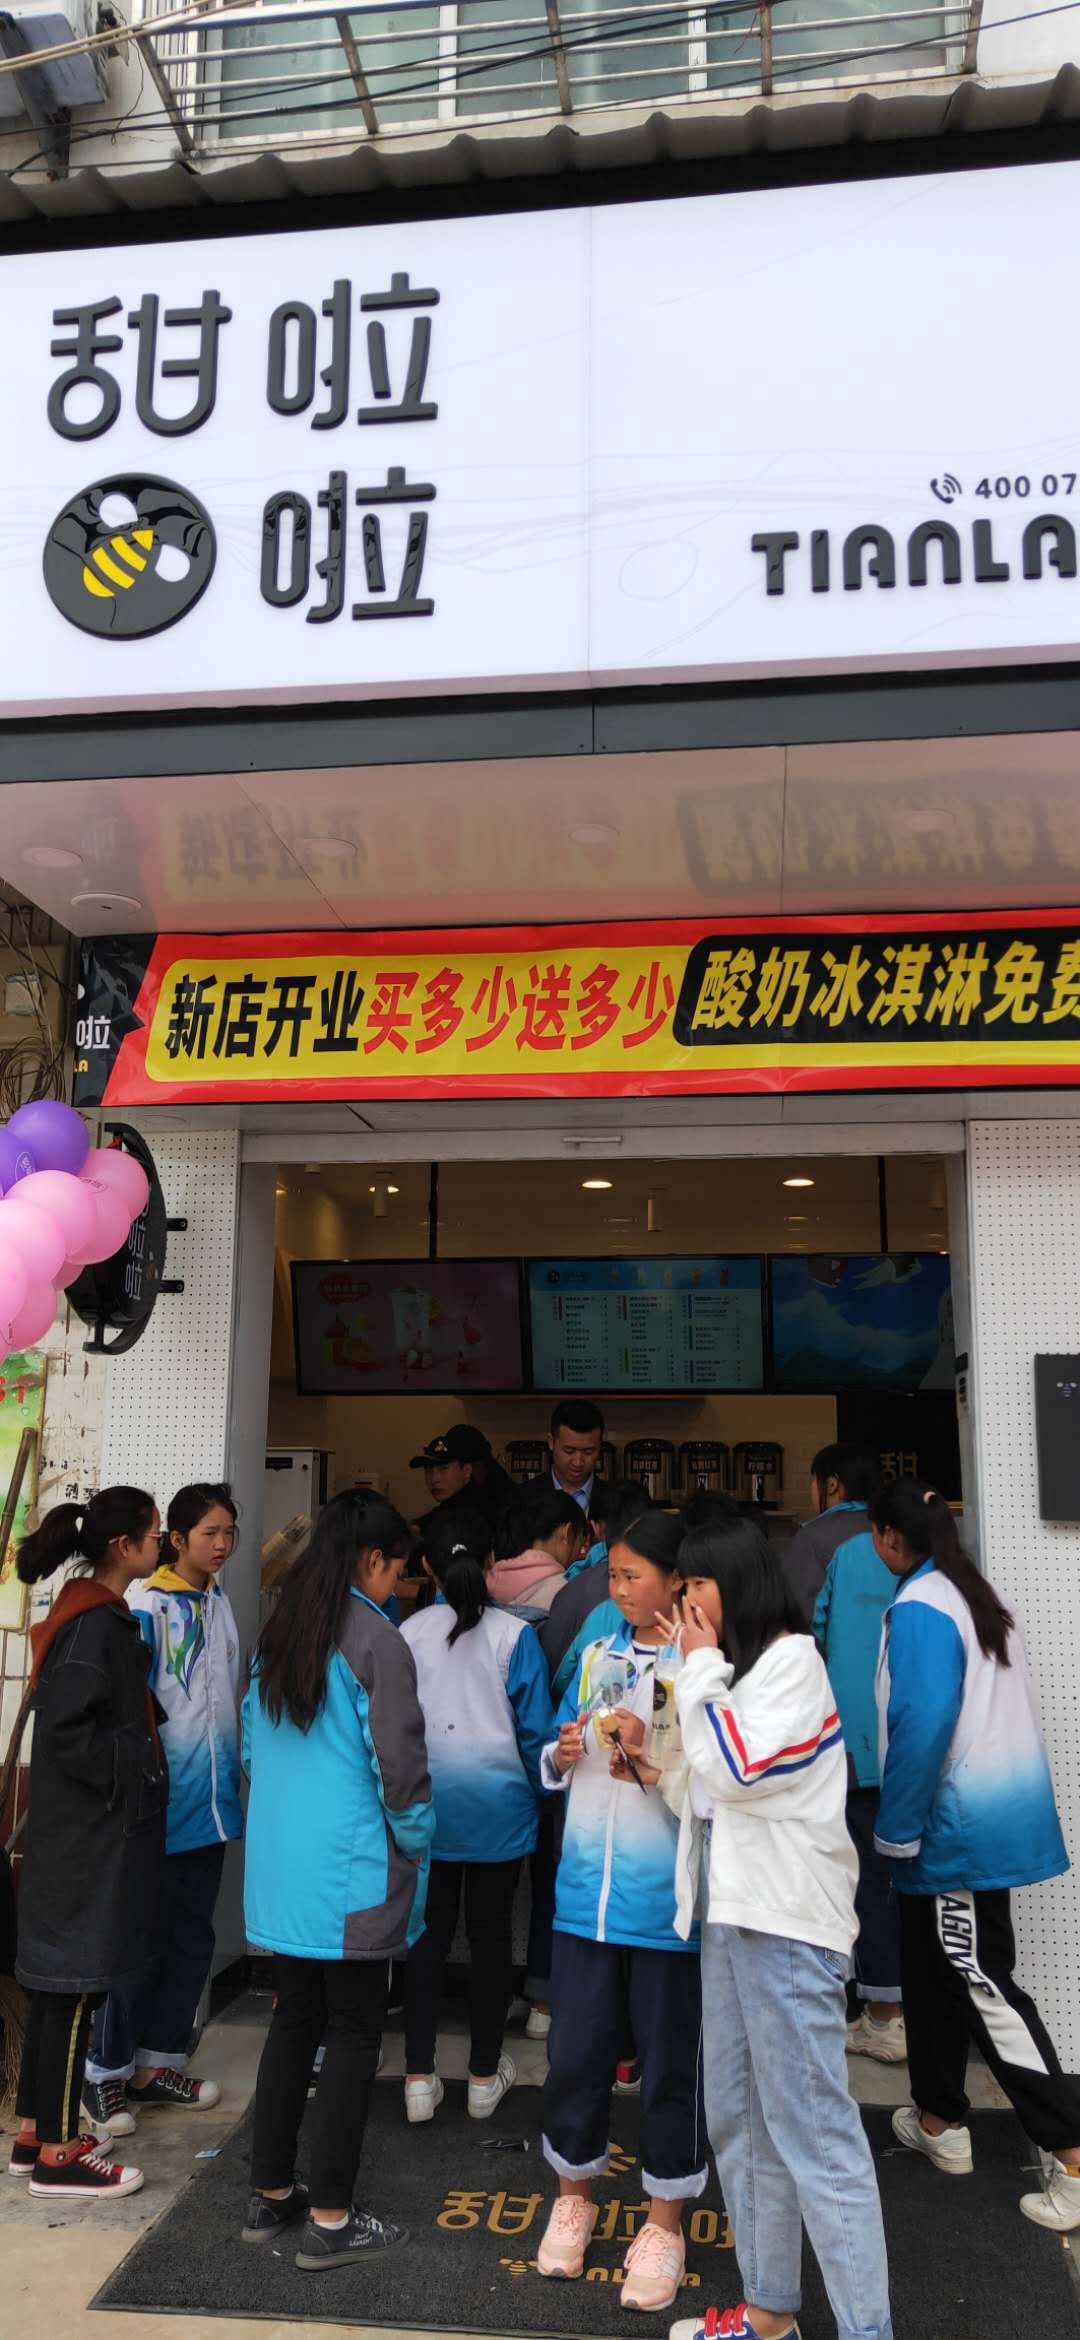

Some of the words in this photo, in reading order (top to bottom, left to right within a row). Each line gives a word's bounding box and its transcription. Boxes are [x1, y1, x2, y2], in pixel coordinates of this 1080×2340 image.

[47, 272, 441, 442] 甜啦
[975, 475, 1032, 499] 400
[1041, 473, 1077, 496] 07
[260, 466, 437, 624] 啦
[751, 513, 1077, 596] TIANLA
[74, 1059, 89, 1072] A
